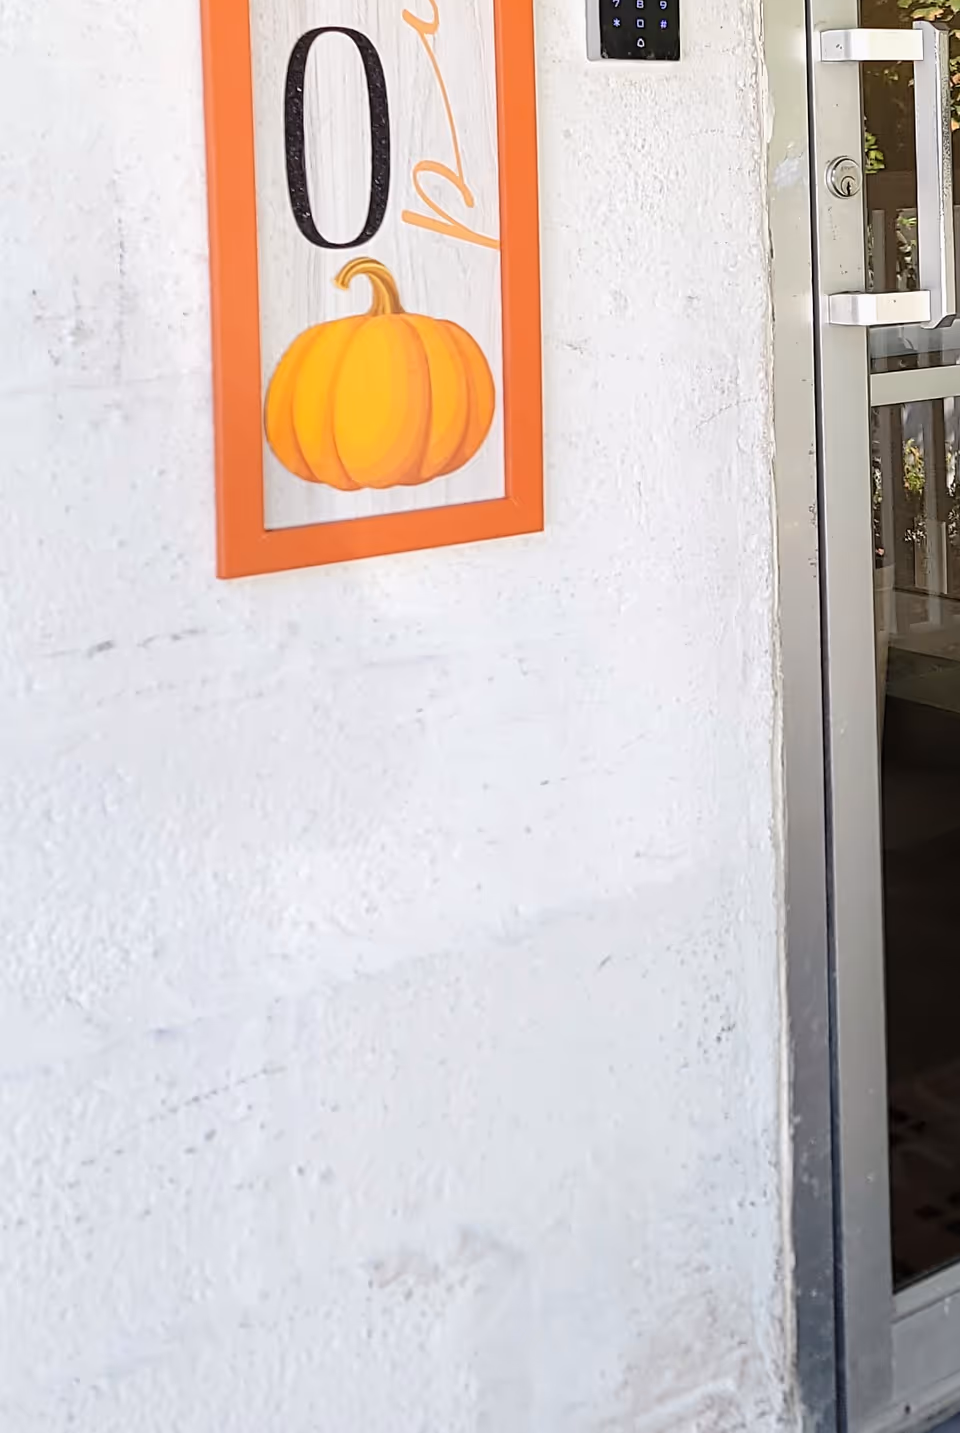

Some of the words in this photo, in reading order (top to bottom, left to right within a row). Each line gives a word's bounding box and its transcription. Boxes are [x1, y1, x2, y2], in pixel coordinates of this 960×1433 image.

[612, 0, 620, 7] 7
[637, 0, 644, 8] 8
[660, 1, 667, 9] 9
[637, 19, 644, 28] 0
